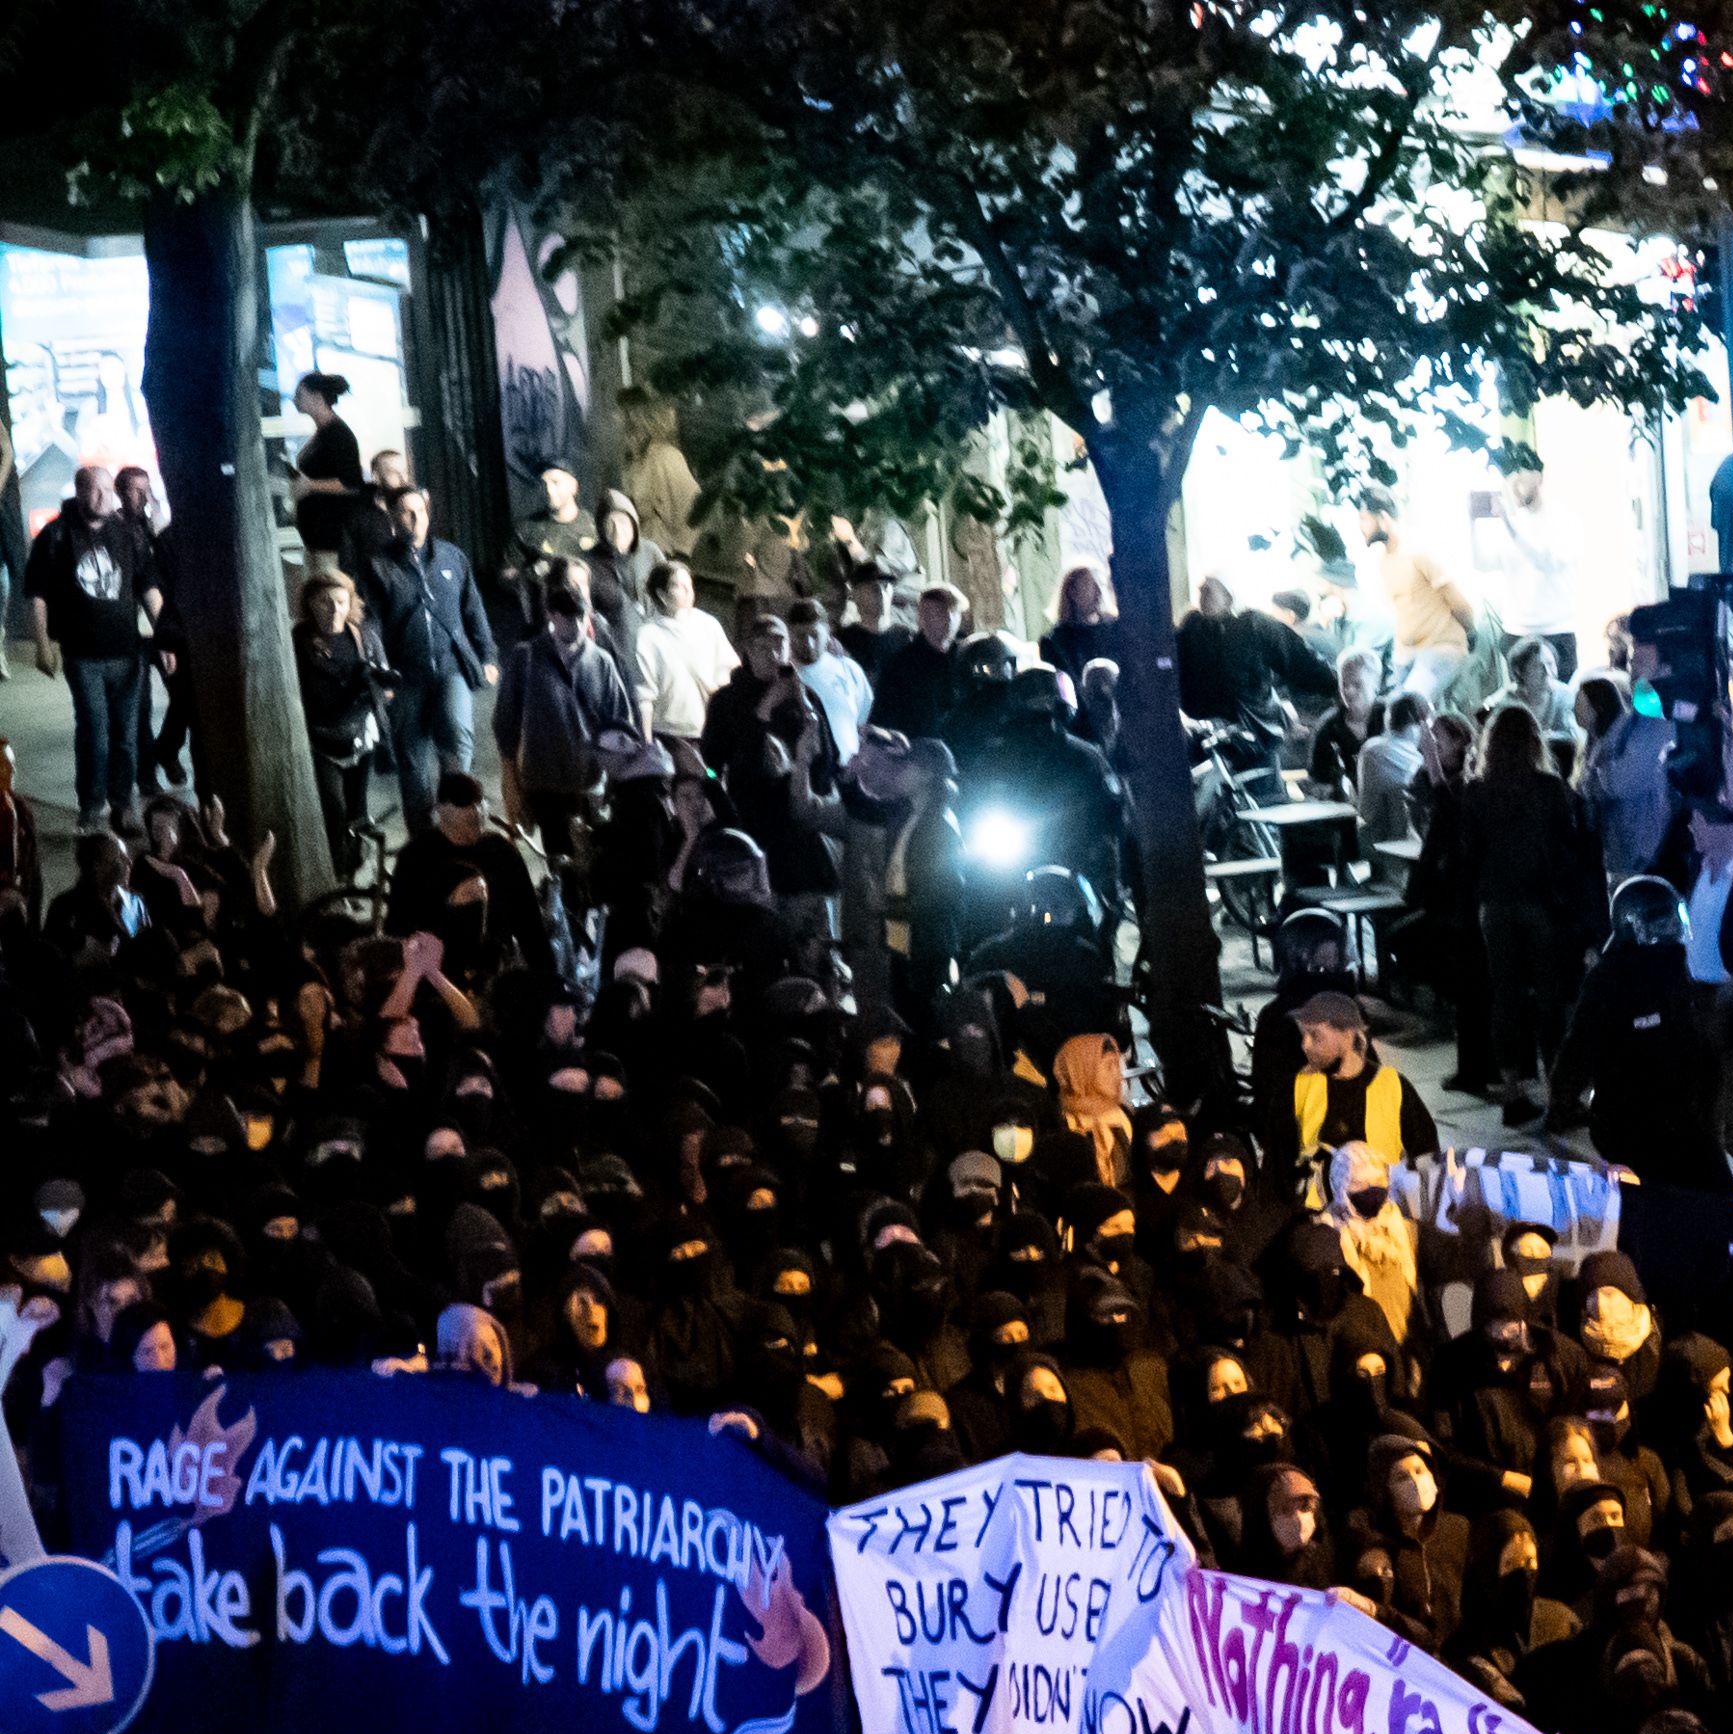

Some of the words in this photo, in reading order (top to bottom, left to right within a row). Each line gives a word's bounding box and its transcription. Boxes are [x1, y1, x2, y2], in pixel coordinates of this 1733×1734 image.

[109, 1436, 228, 1510] RAGE
[244, 1435, 424, 1511] AGAINST
[440, 1447, 522, 1533] THE
[541, 1465, 786, 1612] PATRIARCHY
[850, 1483, 1004, 1554] THEY
[1127, 1514, 1175, 1603] TO
[113, 1518, 263, 1650] take
[269, 1521, 452, 1668] back
[459, 1536, 559, 1687] the
[885, 1562, 1023, 1645] BURY
[1008, 1661, 1090, 1724] DIDN'
